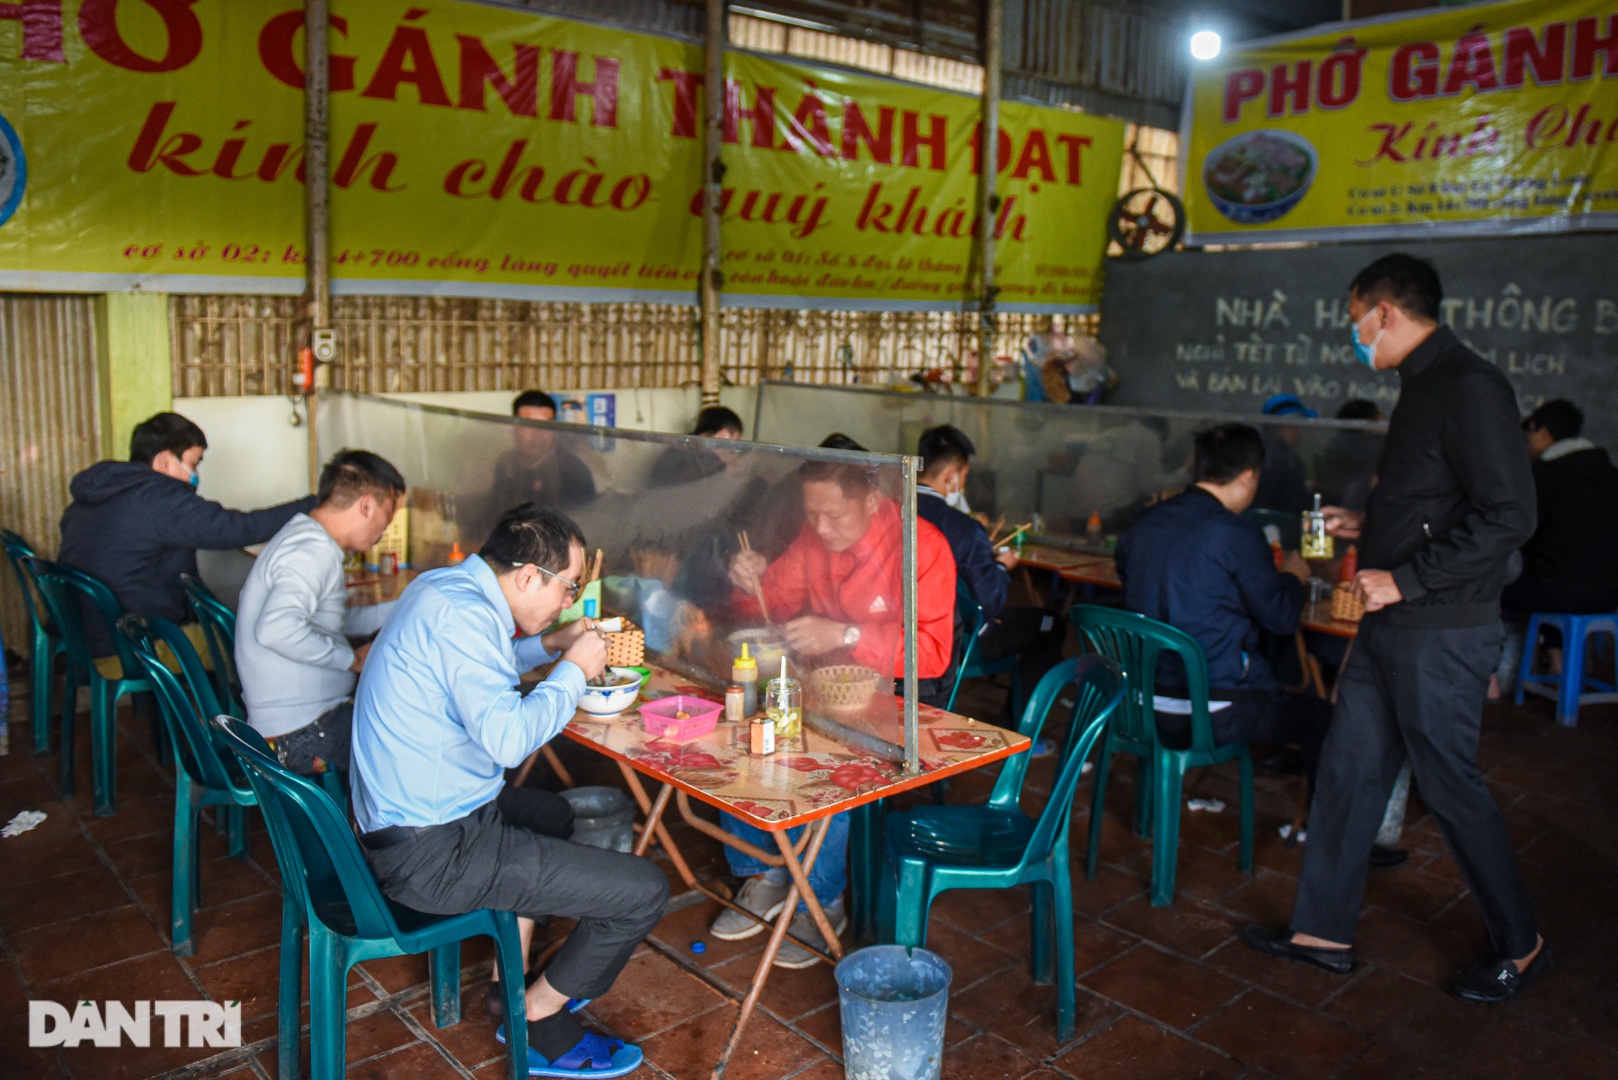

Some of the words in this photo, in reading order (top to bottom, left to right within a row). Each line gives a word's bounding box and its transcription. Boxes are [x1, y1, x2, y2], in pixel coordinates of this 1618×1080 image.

[258, 8, 621, 129] GÁNH
[656, 66, 948, 172] THÀNH
[968, 114, 1093, 195] ĐẠT
[1222, 36, 1370, 123] PHỞ
[1388, 13, 1618, 102] GÁNH
[127, 101, 408, 192] kính
[443, 138, 660, 212] chào
[690, 182, 832, 238] quý
[1355, 112, 1501, 167] Kính
[221, 243, 271, 263] 02:
[1215, 288, 1291, 329] NHÀ
[1441, 282, 1578, 334] THÔNG
